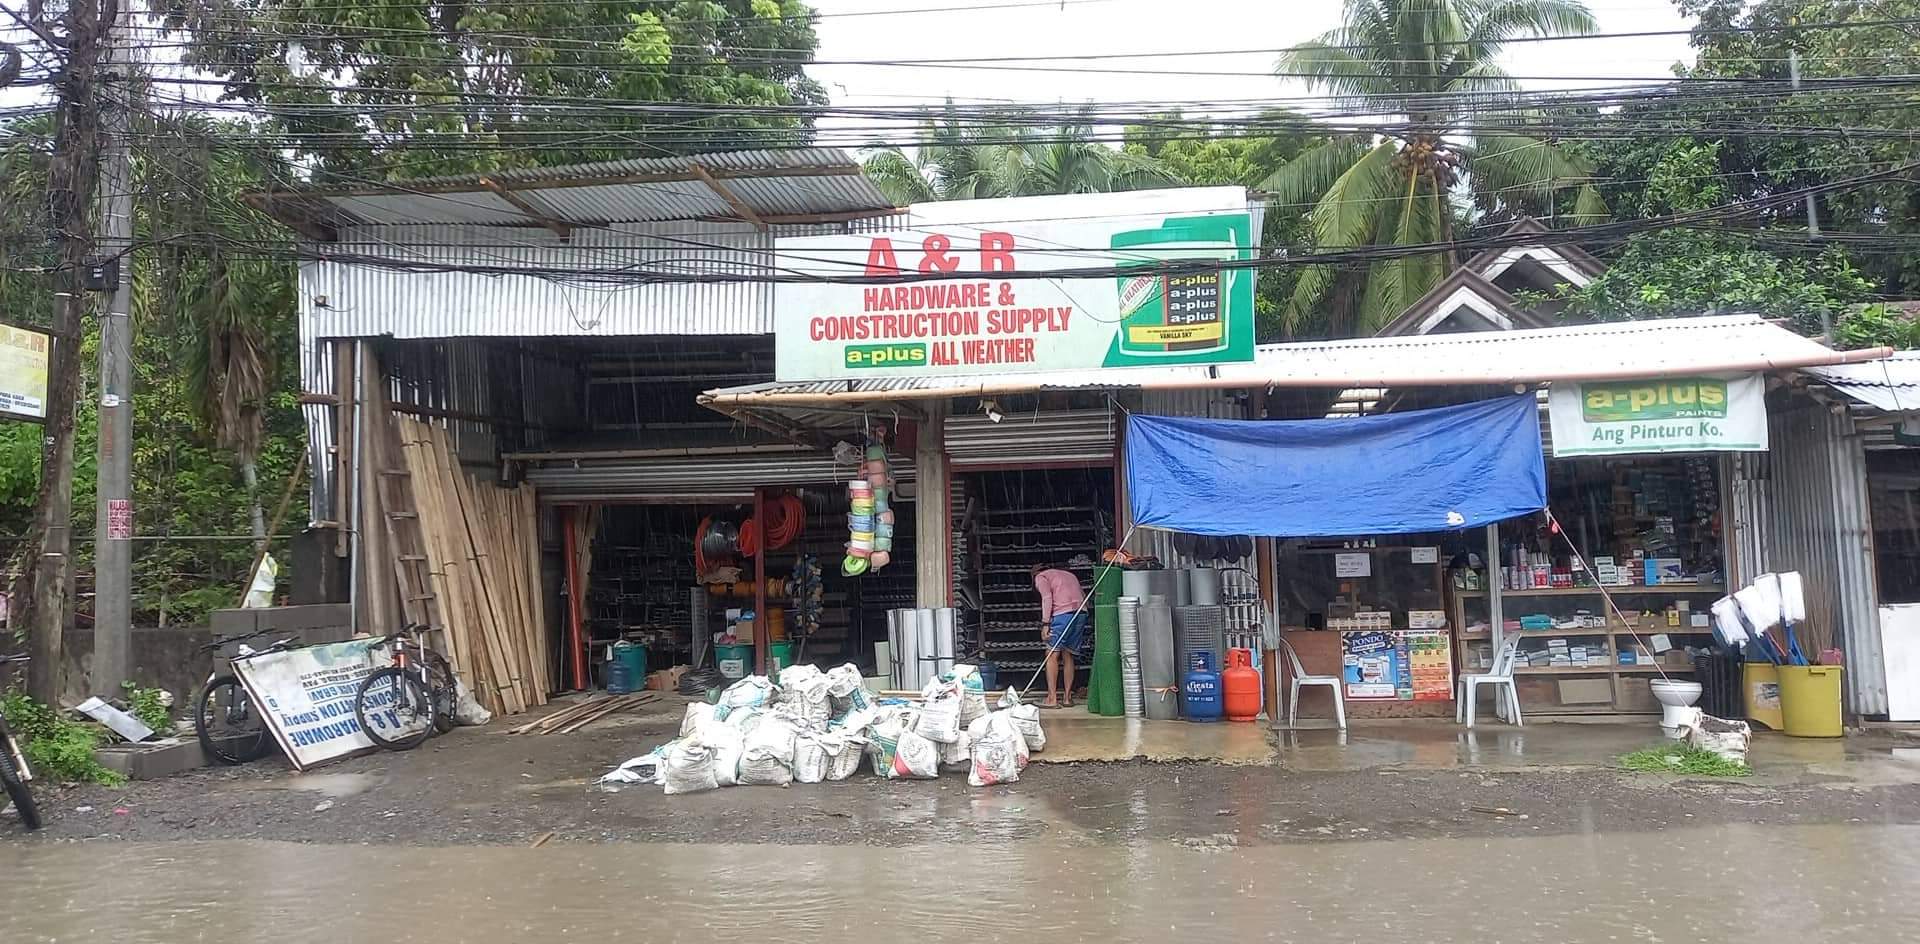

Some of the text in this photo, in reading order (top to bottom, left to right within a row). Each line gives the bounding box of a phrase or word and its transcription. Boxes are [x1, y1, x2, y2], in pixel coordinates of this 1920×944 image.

[864, 232, 1015, 279] A & R
[1170, 275, 1217, 286] a-plus
[863, 281, 1016, 312] HARDWARE &
[1170, 287, 1217, 298] a-plus
[1170, 299, 1217, 311] a-plus
[810, 307, 1073, 342] CONSTRUCTION SUPPLY
[1170, 312, 1216, 324] a-plus
[846, 338, 1035, 366] a-plus ALL WEATHER
[1586, 383, 1724, 411] a-plus
[1675, 409, 1722, 418] PAINTS
[1592, 421, 1723, 444] Ang Pintura Ko.
[1351, 634, 1384, 646] PONDO
[289, 719, 360, 747] HARDWARE
